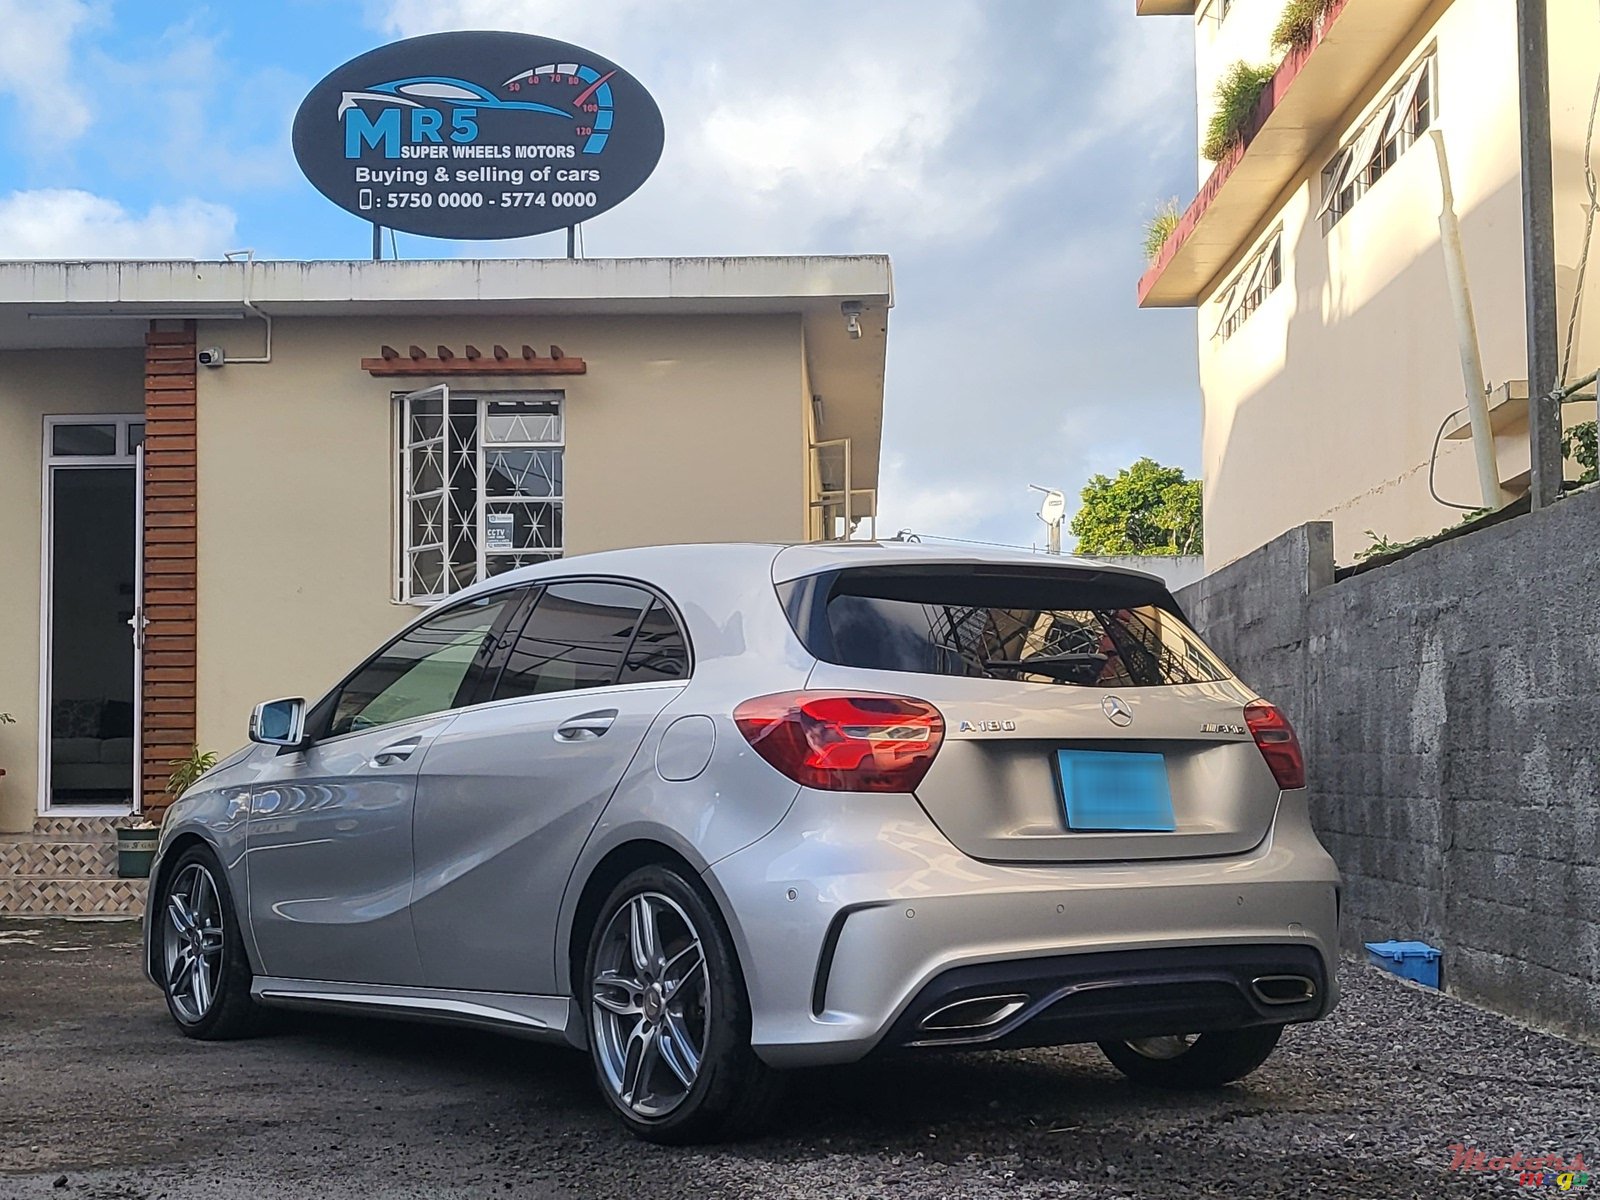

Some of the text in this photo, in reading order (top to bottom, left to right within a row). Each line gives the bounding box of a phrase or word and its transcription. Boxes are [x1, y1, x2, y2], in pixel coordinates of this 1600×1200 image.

[508, 75, 579, 92] 50 60 70 80
[582, 104, 598, 113] 100
[576, 127, 592, 136] 120
[400, 145, 576, 159] SUPER WHEELS MOTORS
[355, 166, 601, 186] Buying & selling of cars
[386, 192, 433, 208] 5750
[437, 192, 483, 208] 0000
[500, 192, 546, 208] 5774
[551, 192, 597, 208] 0000
